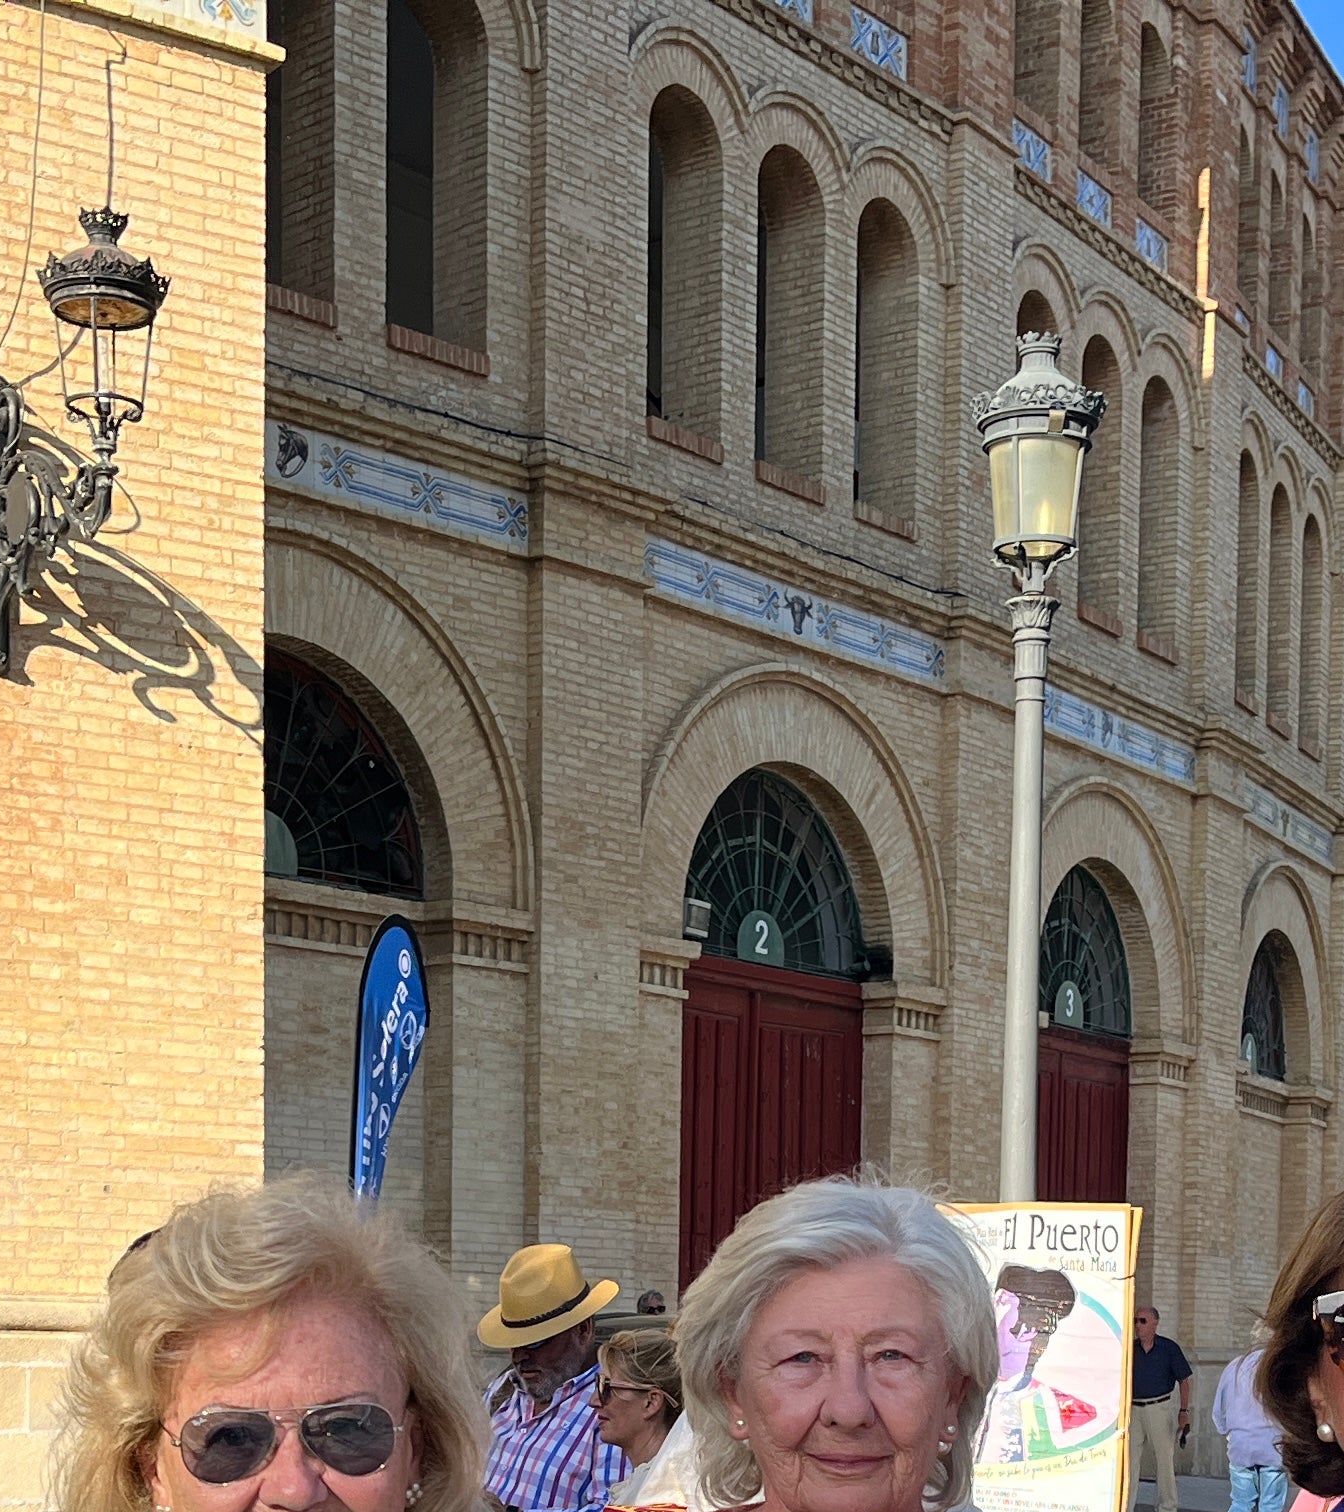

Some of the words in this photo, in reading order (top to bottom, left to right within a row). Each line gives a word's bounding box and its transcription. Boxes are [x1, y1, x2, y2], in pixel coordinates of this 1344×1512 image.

[755, 919, 769, 955] 2
[1066, 988, 1074, 1018] 3
[1003, 1211, 1018, 1251] El
[1059, 1255, 1085, 1272] Santa
